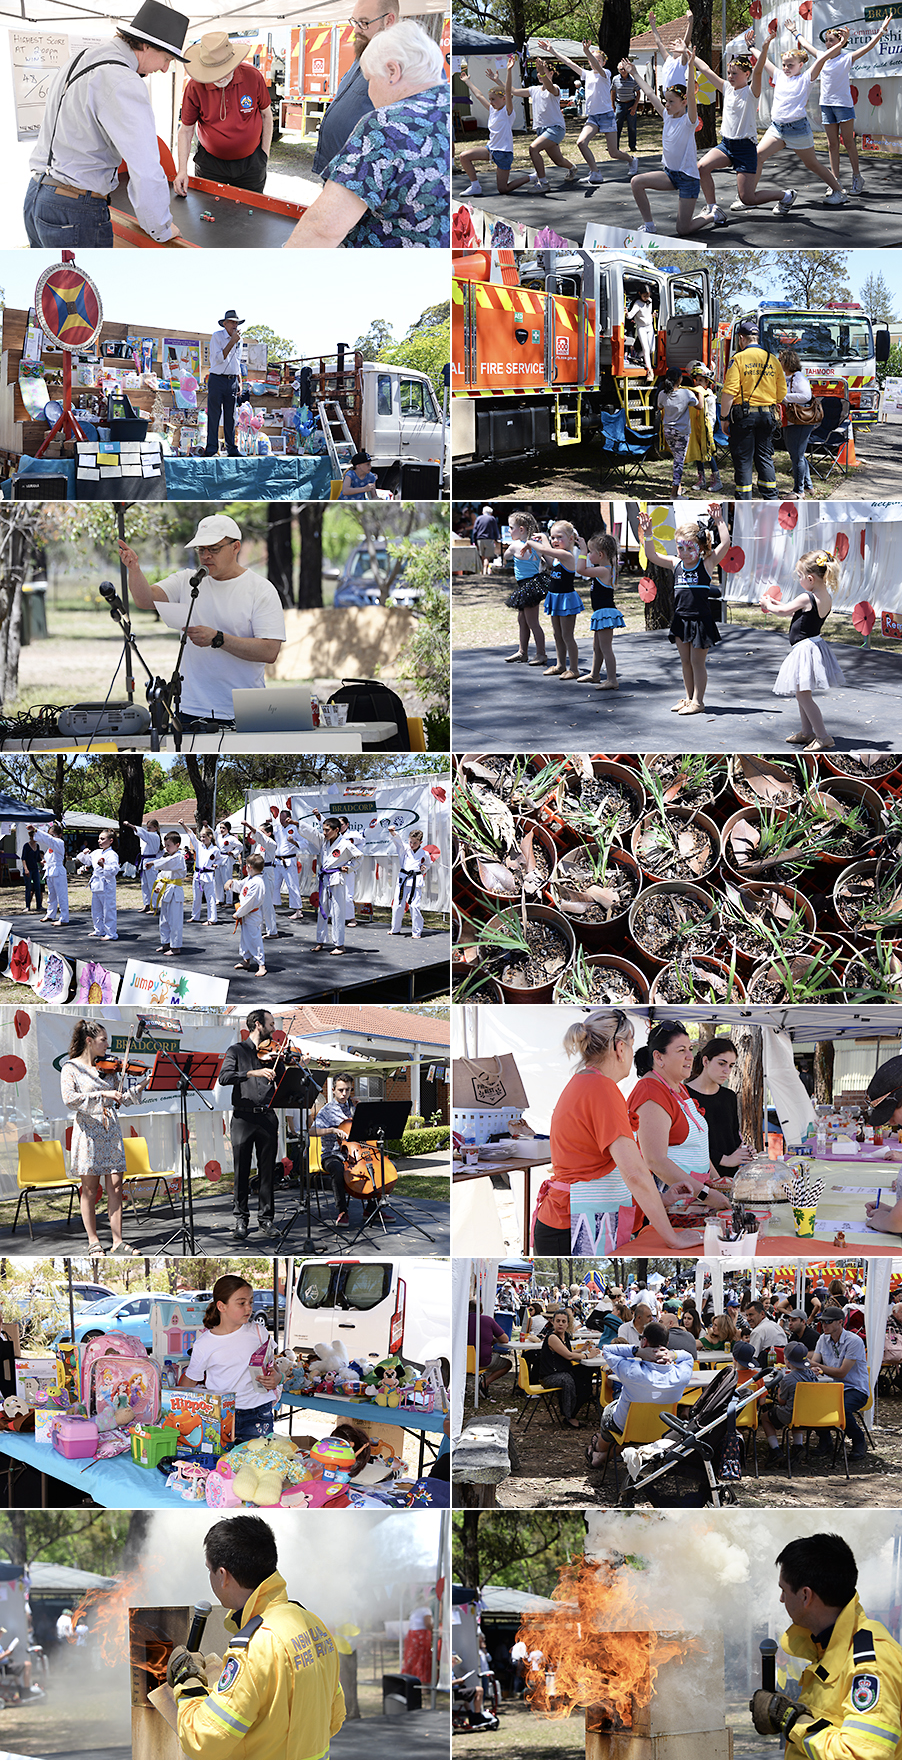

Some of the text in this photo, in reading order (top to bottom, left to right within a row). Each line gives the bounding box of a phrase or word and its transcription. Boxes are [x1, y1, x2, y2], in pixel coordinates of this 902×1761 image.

[480, 362, 545, 374] FIRE SERVICE
[332, 803, 375, 814] BRADCORP
[130, 973, 160, 992] Jumpy
[116, 1038, 178, 1052] BRADCORP
[170, 1398, 214, 1414] Hippos
